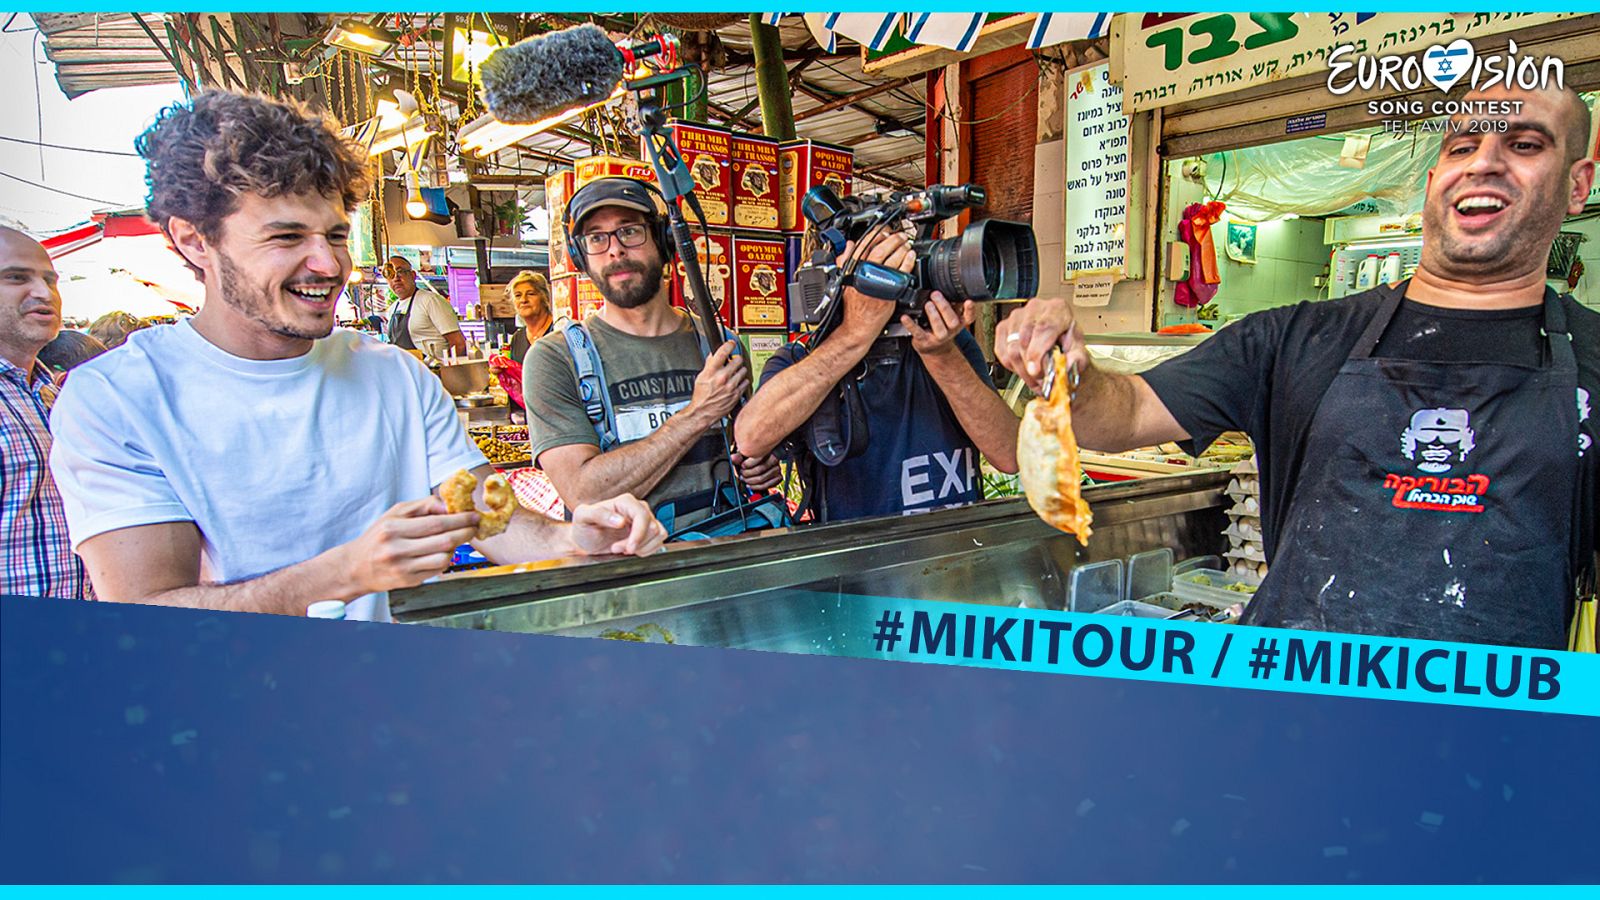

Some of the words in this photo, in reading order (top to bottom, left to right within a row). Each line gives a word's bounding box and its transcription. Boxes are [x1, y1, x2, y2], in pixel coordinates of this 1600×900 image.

[1377, 19, 1456, 53] ברינזה,
[1249, 58, 1280, 81] קש,
[1187, 67, 1243, 96] אורדה,
[1133, 82, 1177, 105] דבורה
[1077, 106, 1103, 122] במיונז
[1106, 101, 1123, 115] ציל
[1083, 123, 1104, 137] אדום
[1107, 117, 1128, 131] כרוב
[680, 130, 728, 146] THRUMBA
[680, 140, 691, 149] OF
[695, 142, 729, 154] THASSOS
[731, 142, 776, 155] THRUMBA
[731, 150, 742, 158] OF
[744, 151, 777, 163] THASSOS
[1105, 153, 1127, 166] חציל
[1081, 158, 1102, 171] פרוס
[1090, 174, 1102, 187] על
[1105, 170, 1126, 183] חציל
[1067, 178, 1087, 191] האש
[1105, 187, 1126, 200] טונה
[1094, 204, 1126, 220] אבוקדו
[1076, 224, 1100, 239] בלקני
[1074, 241, 1094, 254] לבנה
[1096, 238, 1124, 253] איקרה
[1067, 258, 1094, 271] אדומה
[1096, 255, 1124, 269] איקרה
[618, 375, 696, 399] CONSTANT
[1406, 488, 1451, 504] הכרמל
[1451, 494, 1478, 506] שוק
